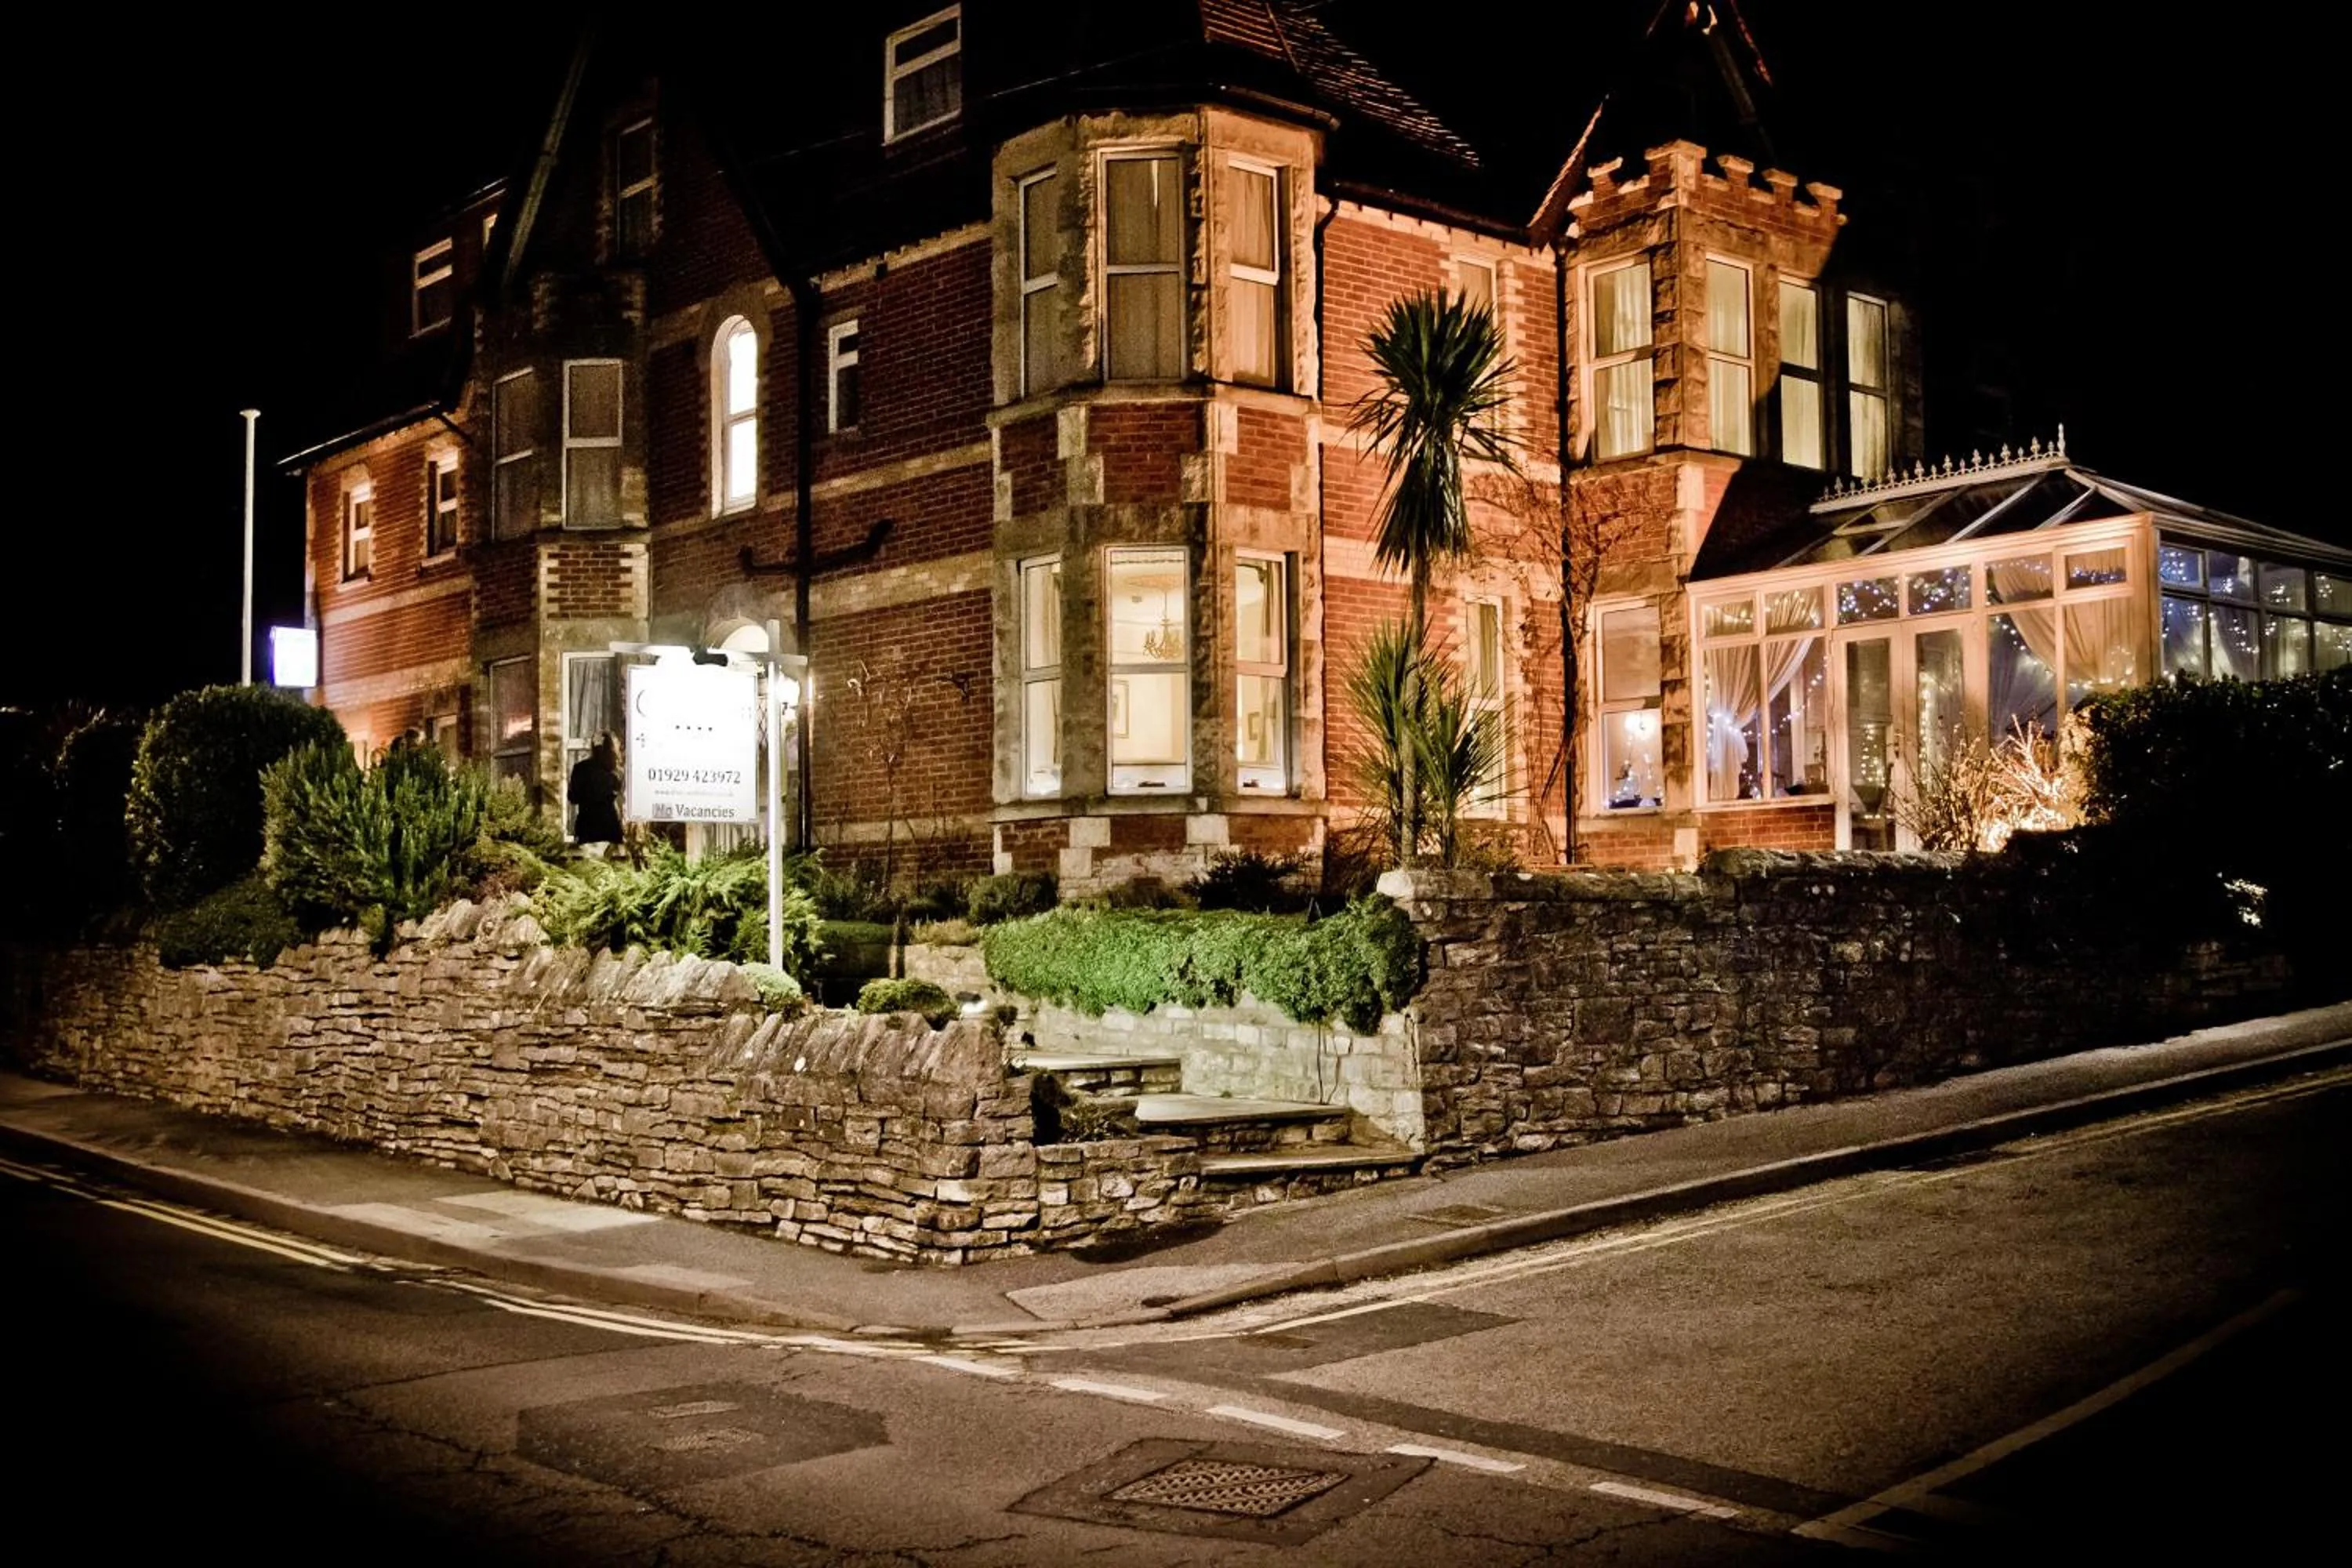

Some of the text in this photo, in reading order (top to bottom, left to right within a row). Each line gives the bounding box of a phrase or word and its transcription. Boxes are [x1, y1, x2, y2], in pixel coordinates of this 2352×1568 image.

[648, 768, 741, 784] 01929 423972
[675, 804, 735, 818] Vacancies
